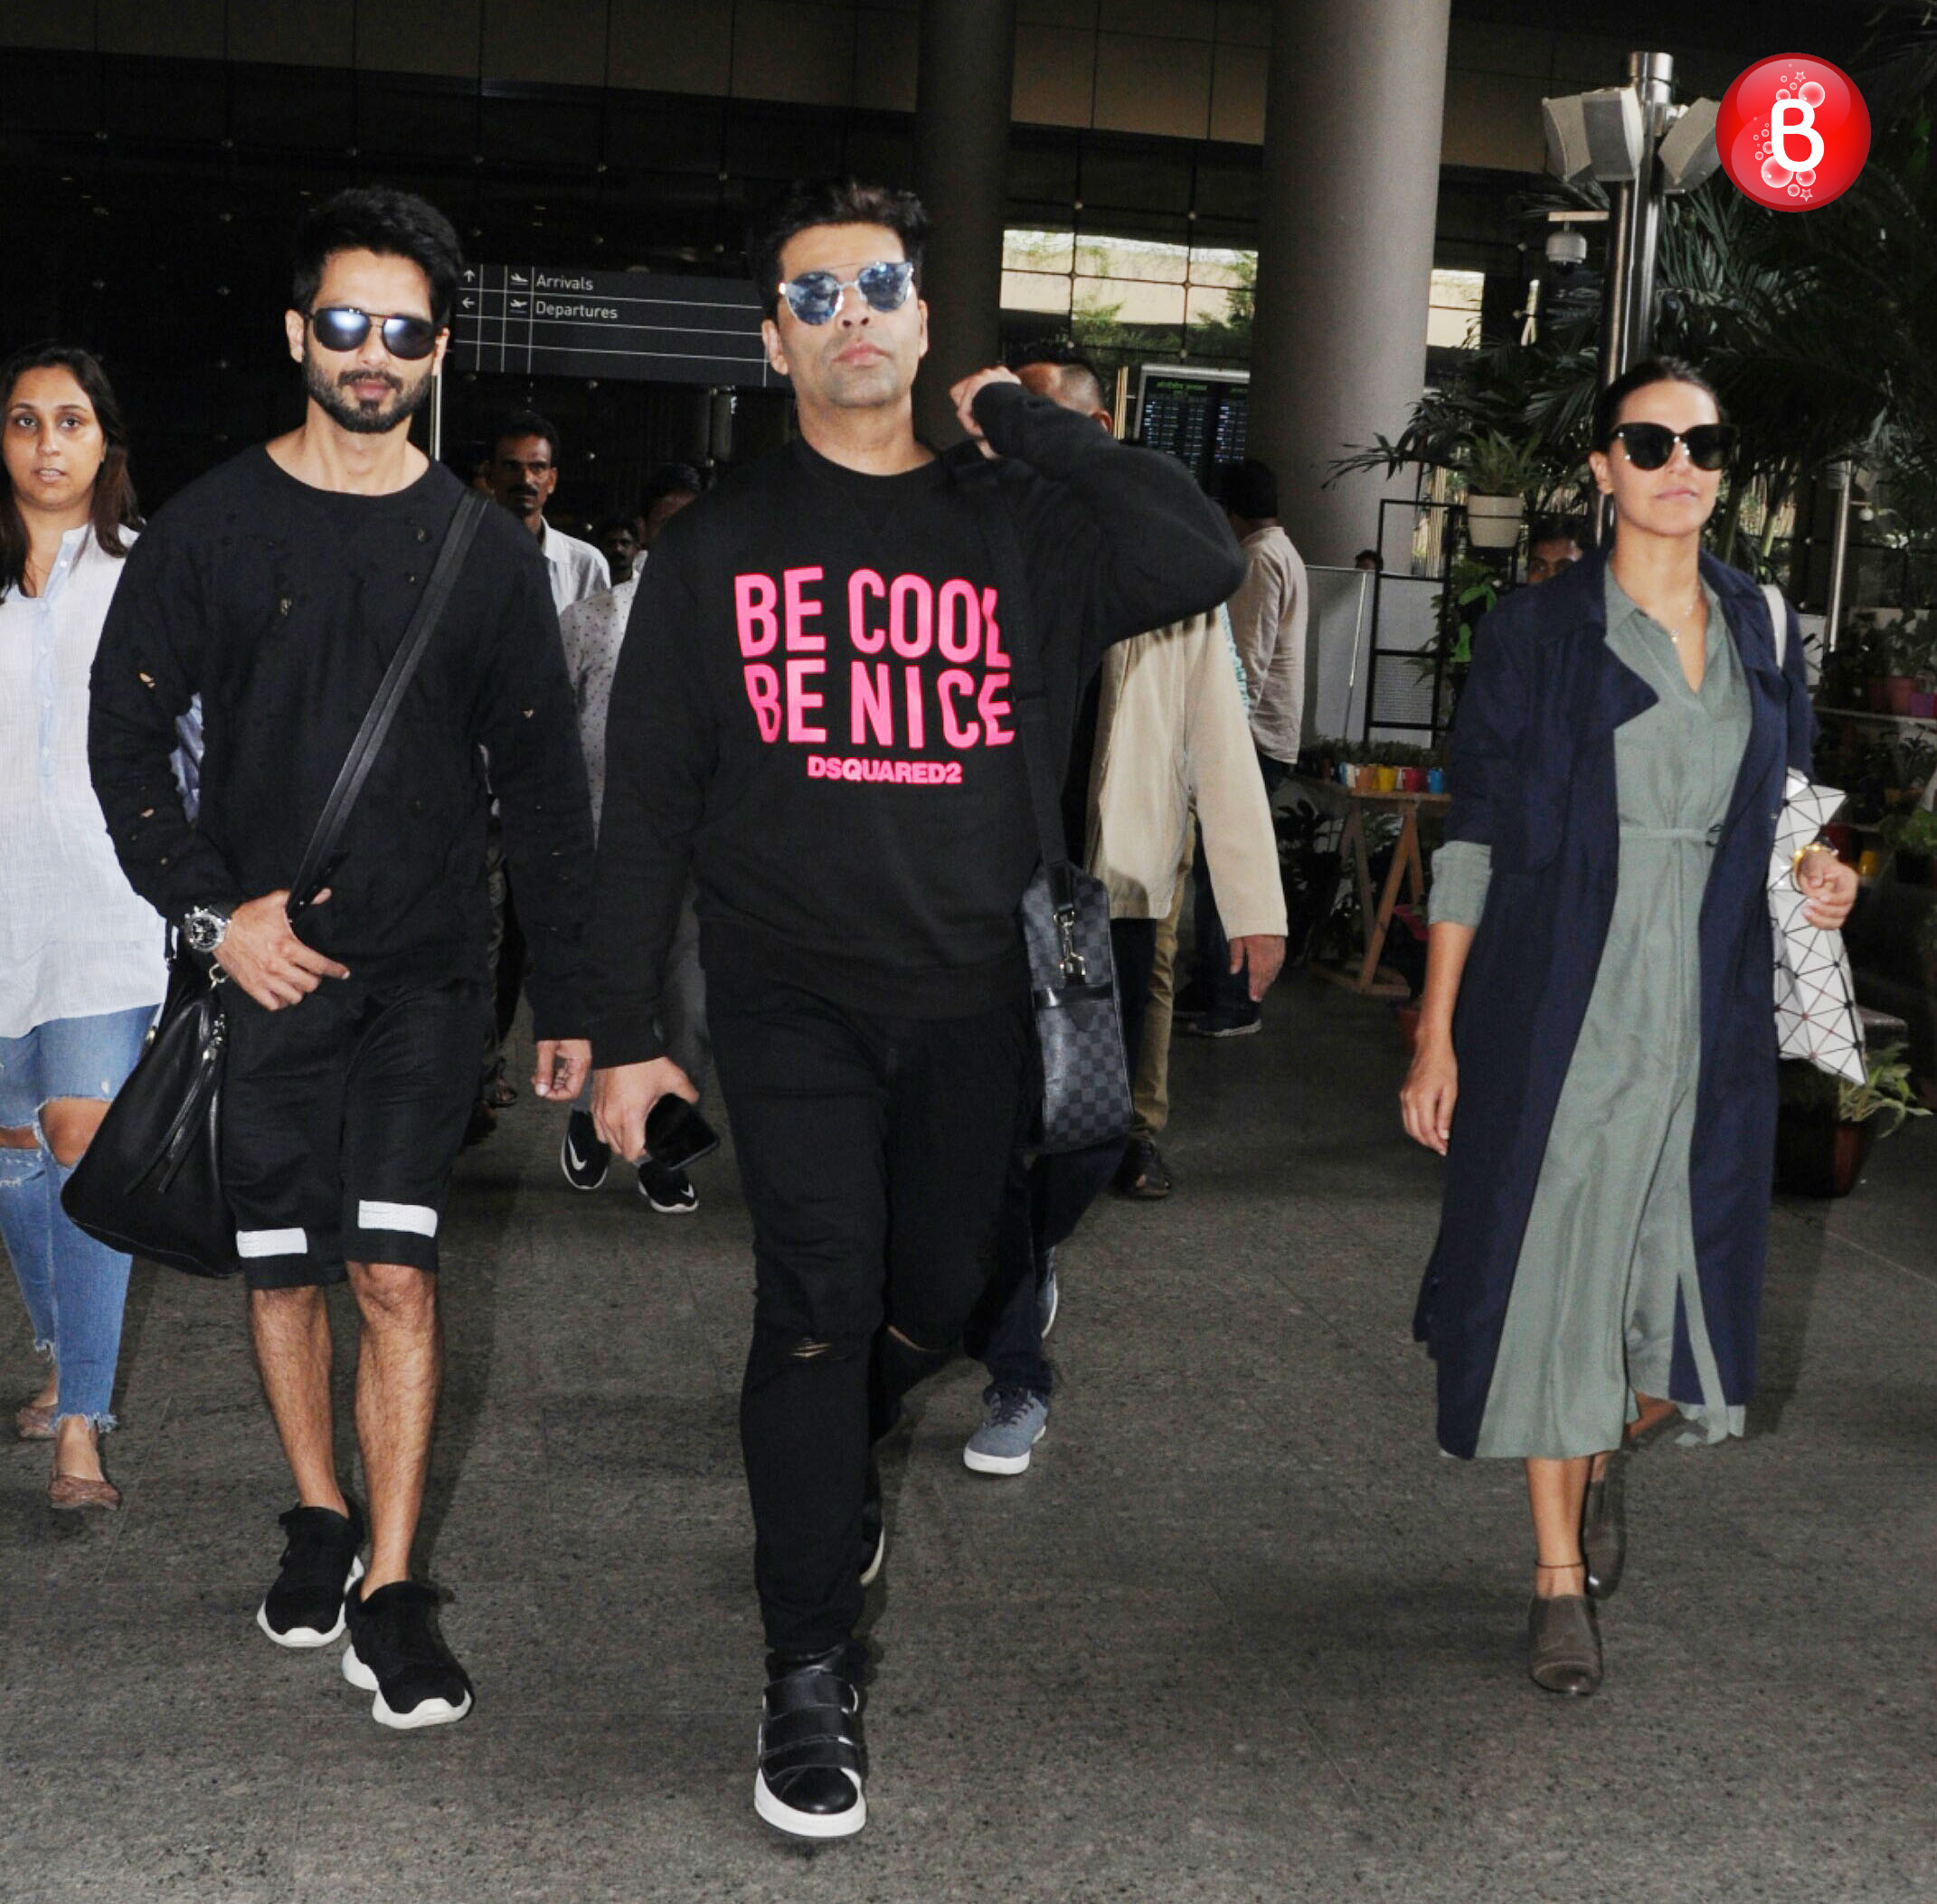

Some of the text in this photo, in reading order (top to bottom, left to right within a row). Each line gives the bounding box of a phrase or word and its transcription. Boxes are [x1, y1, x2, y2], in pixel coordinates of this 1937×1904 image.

[536, 274, 594, 291] Arrivals
[535, 300, 619, 320] Departures
[733, 565, 1012, 668] BE COOL
[743, 658, 1016, 749] BE NICE
[806, 754, 963, 785] DSQUARED2
